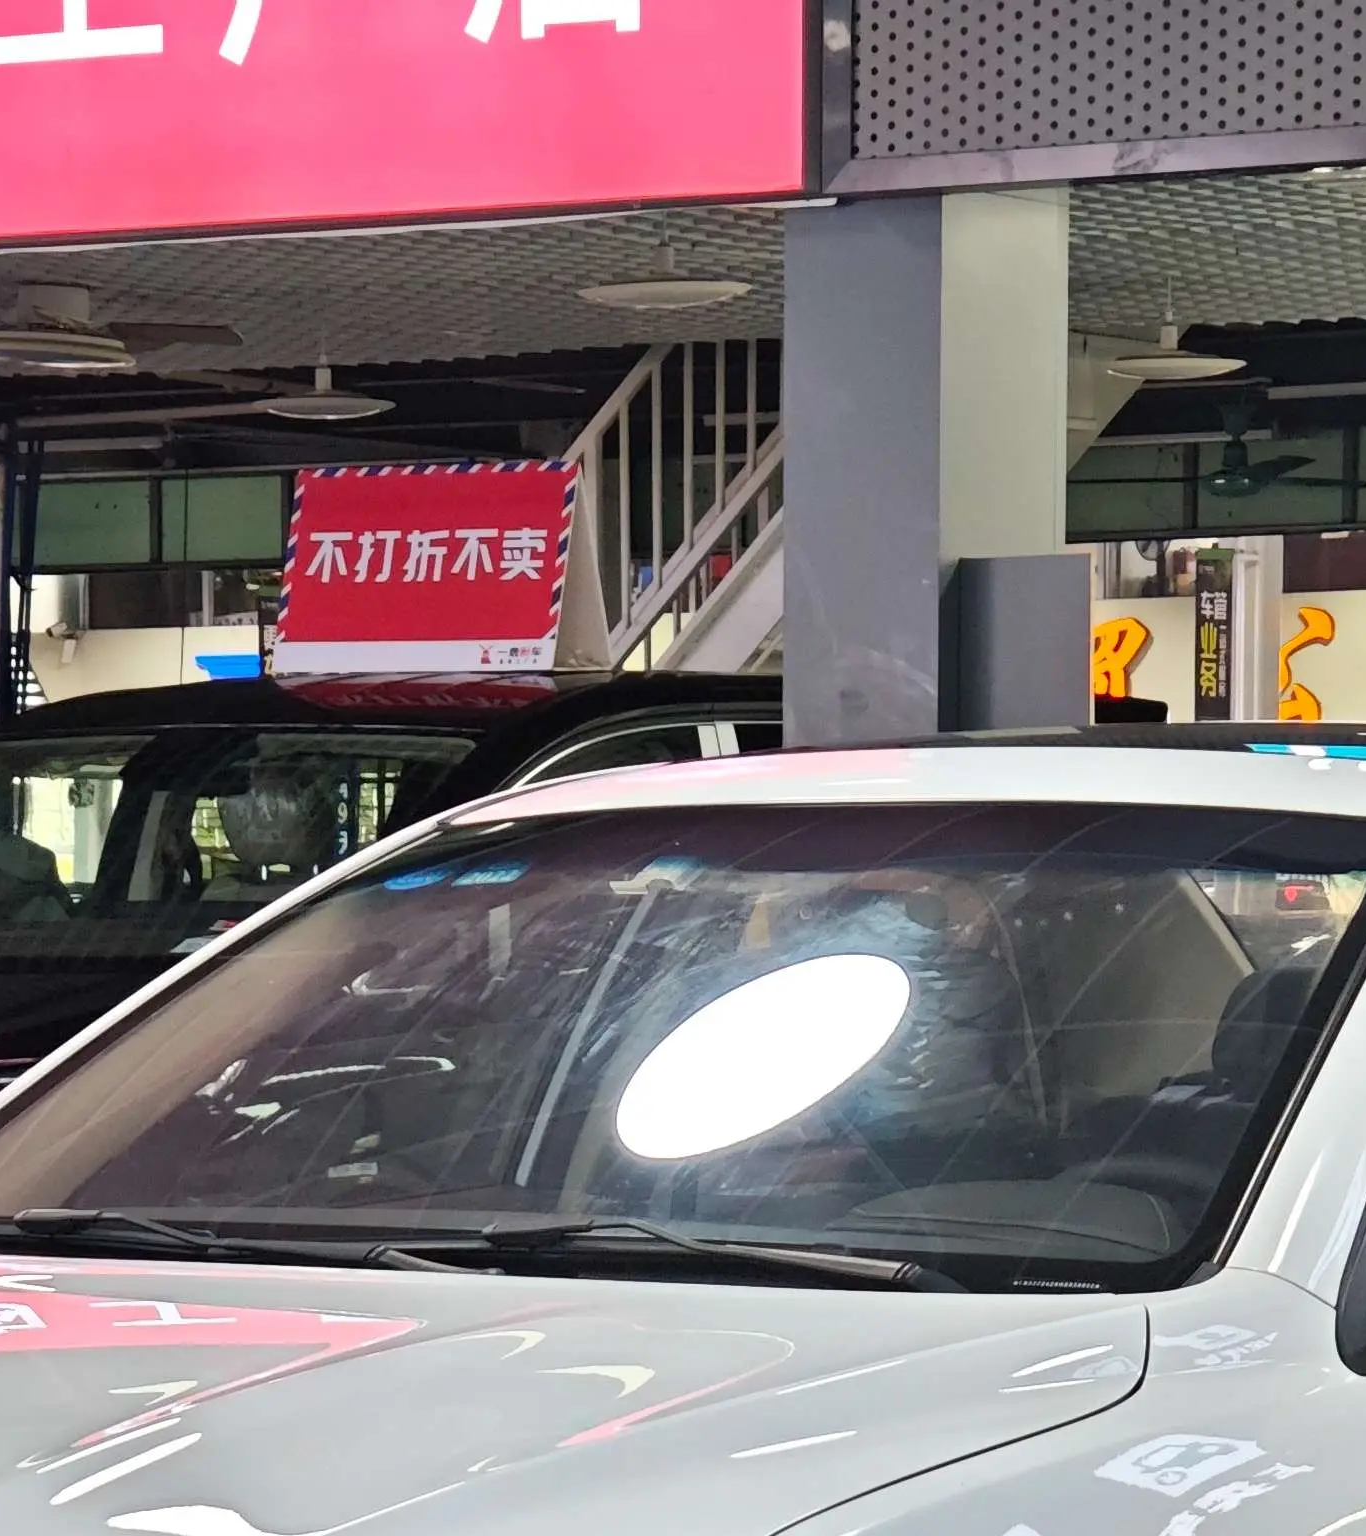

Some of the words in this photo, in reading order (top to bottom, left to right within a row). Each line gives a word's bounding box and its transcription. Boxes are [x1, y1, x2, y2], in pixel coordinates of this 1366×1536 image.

[306, 527, 549, 584] 不打折不卖
